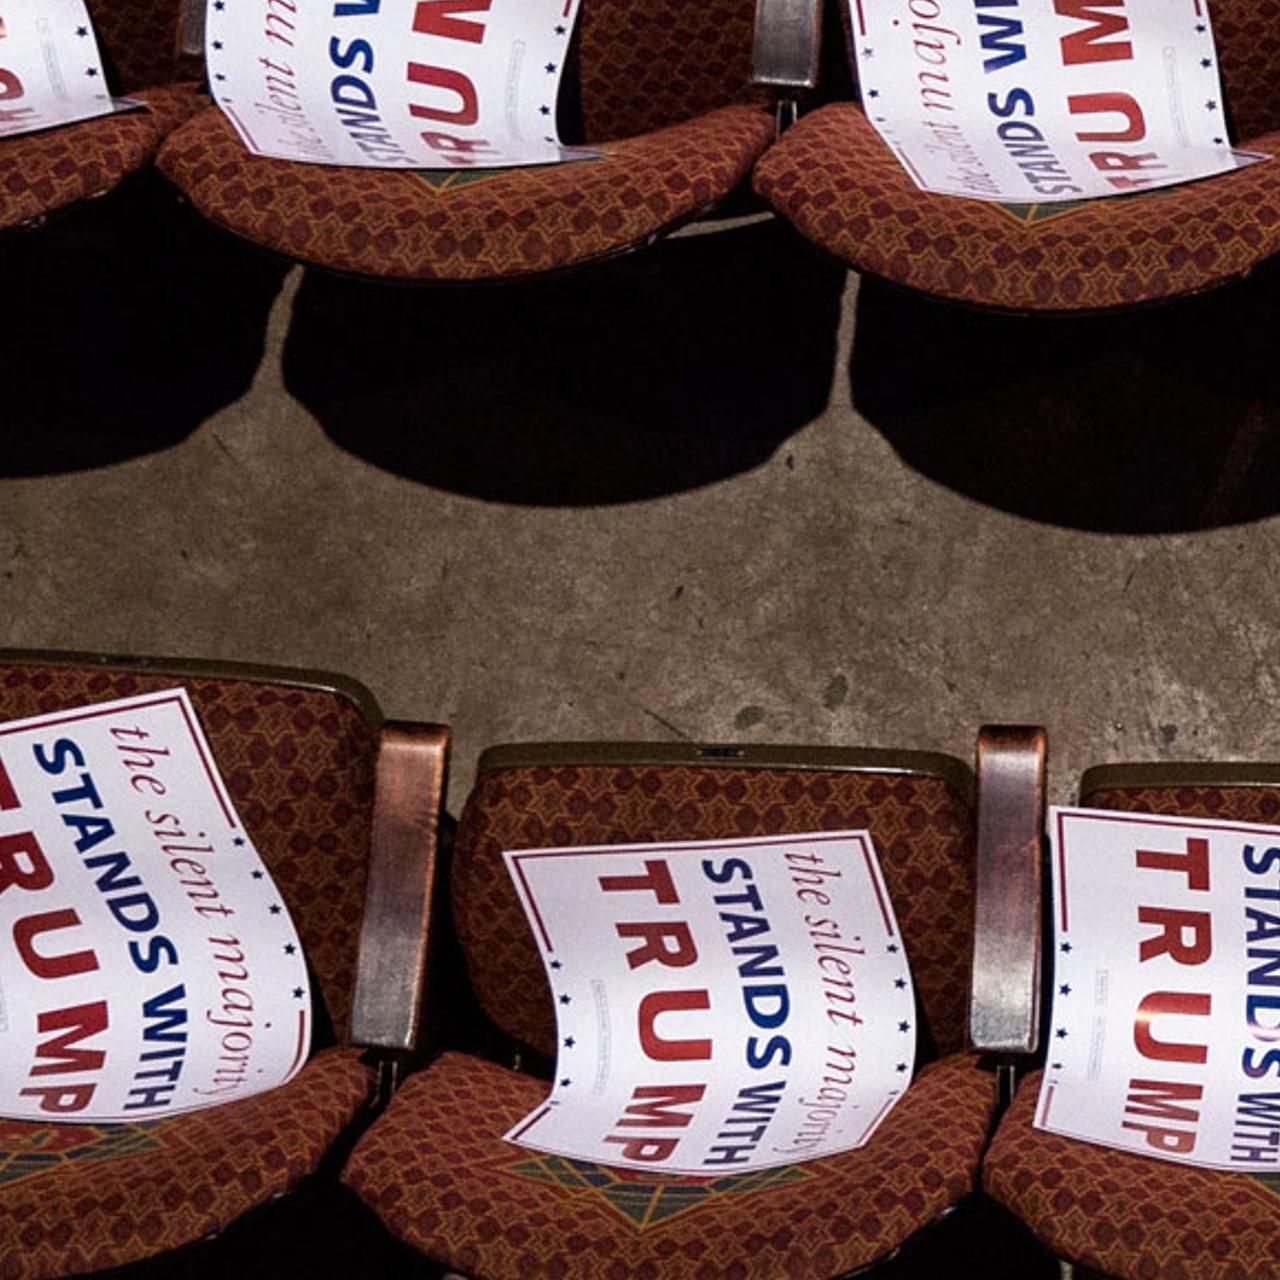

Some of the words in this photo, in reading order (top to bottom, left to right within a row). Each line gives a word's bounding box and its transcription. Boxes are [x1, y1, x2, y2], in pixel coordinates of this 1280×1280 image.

[988, 86, 1083, 195] STANDS
[110, 725, 171, 795] the
[145, 810, 234, 919] silent
[784, 852, 841, 906] the
[0, 758, 109, 1113] RUMP
[32, 738, 179, 974] STANDS
[123, 983, 188, 1111] WITH
[598, 859, 713, 1163] TRUMP
[701, 857, 792, 1069] STANDS
[805, 916, 865, 1026] silent
[1122, 837, 1213, 1154] TRUMP
[703, 1080, 786, 1166] WITH
